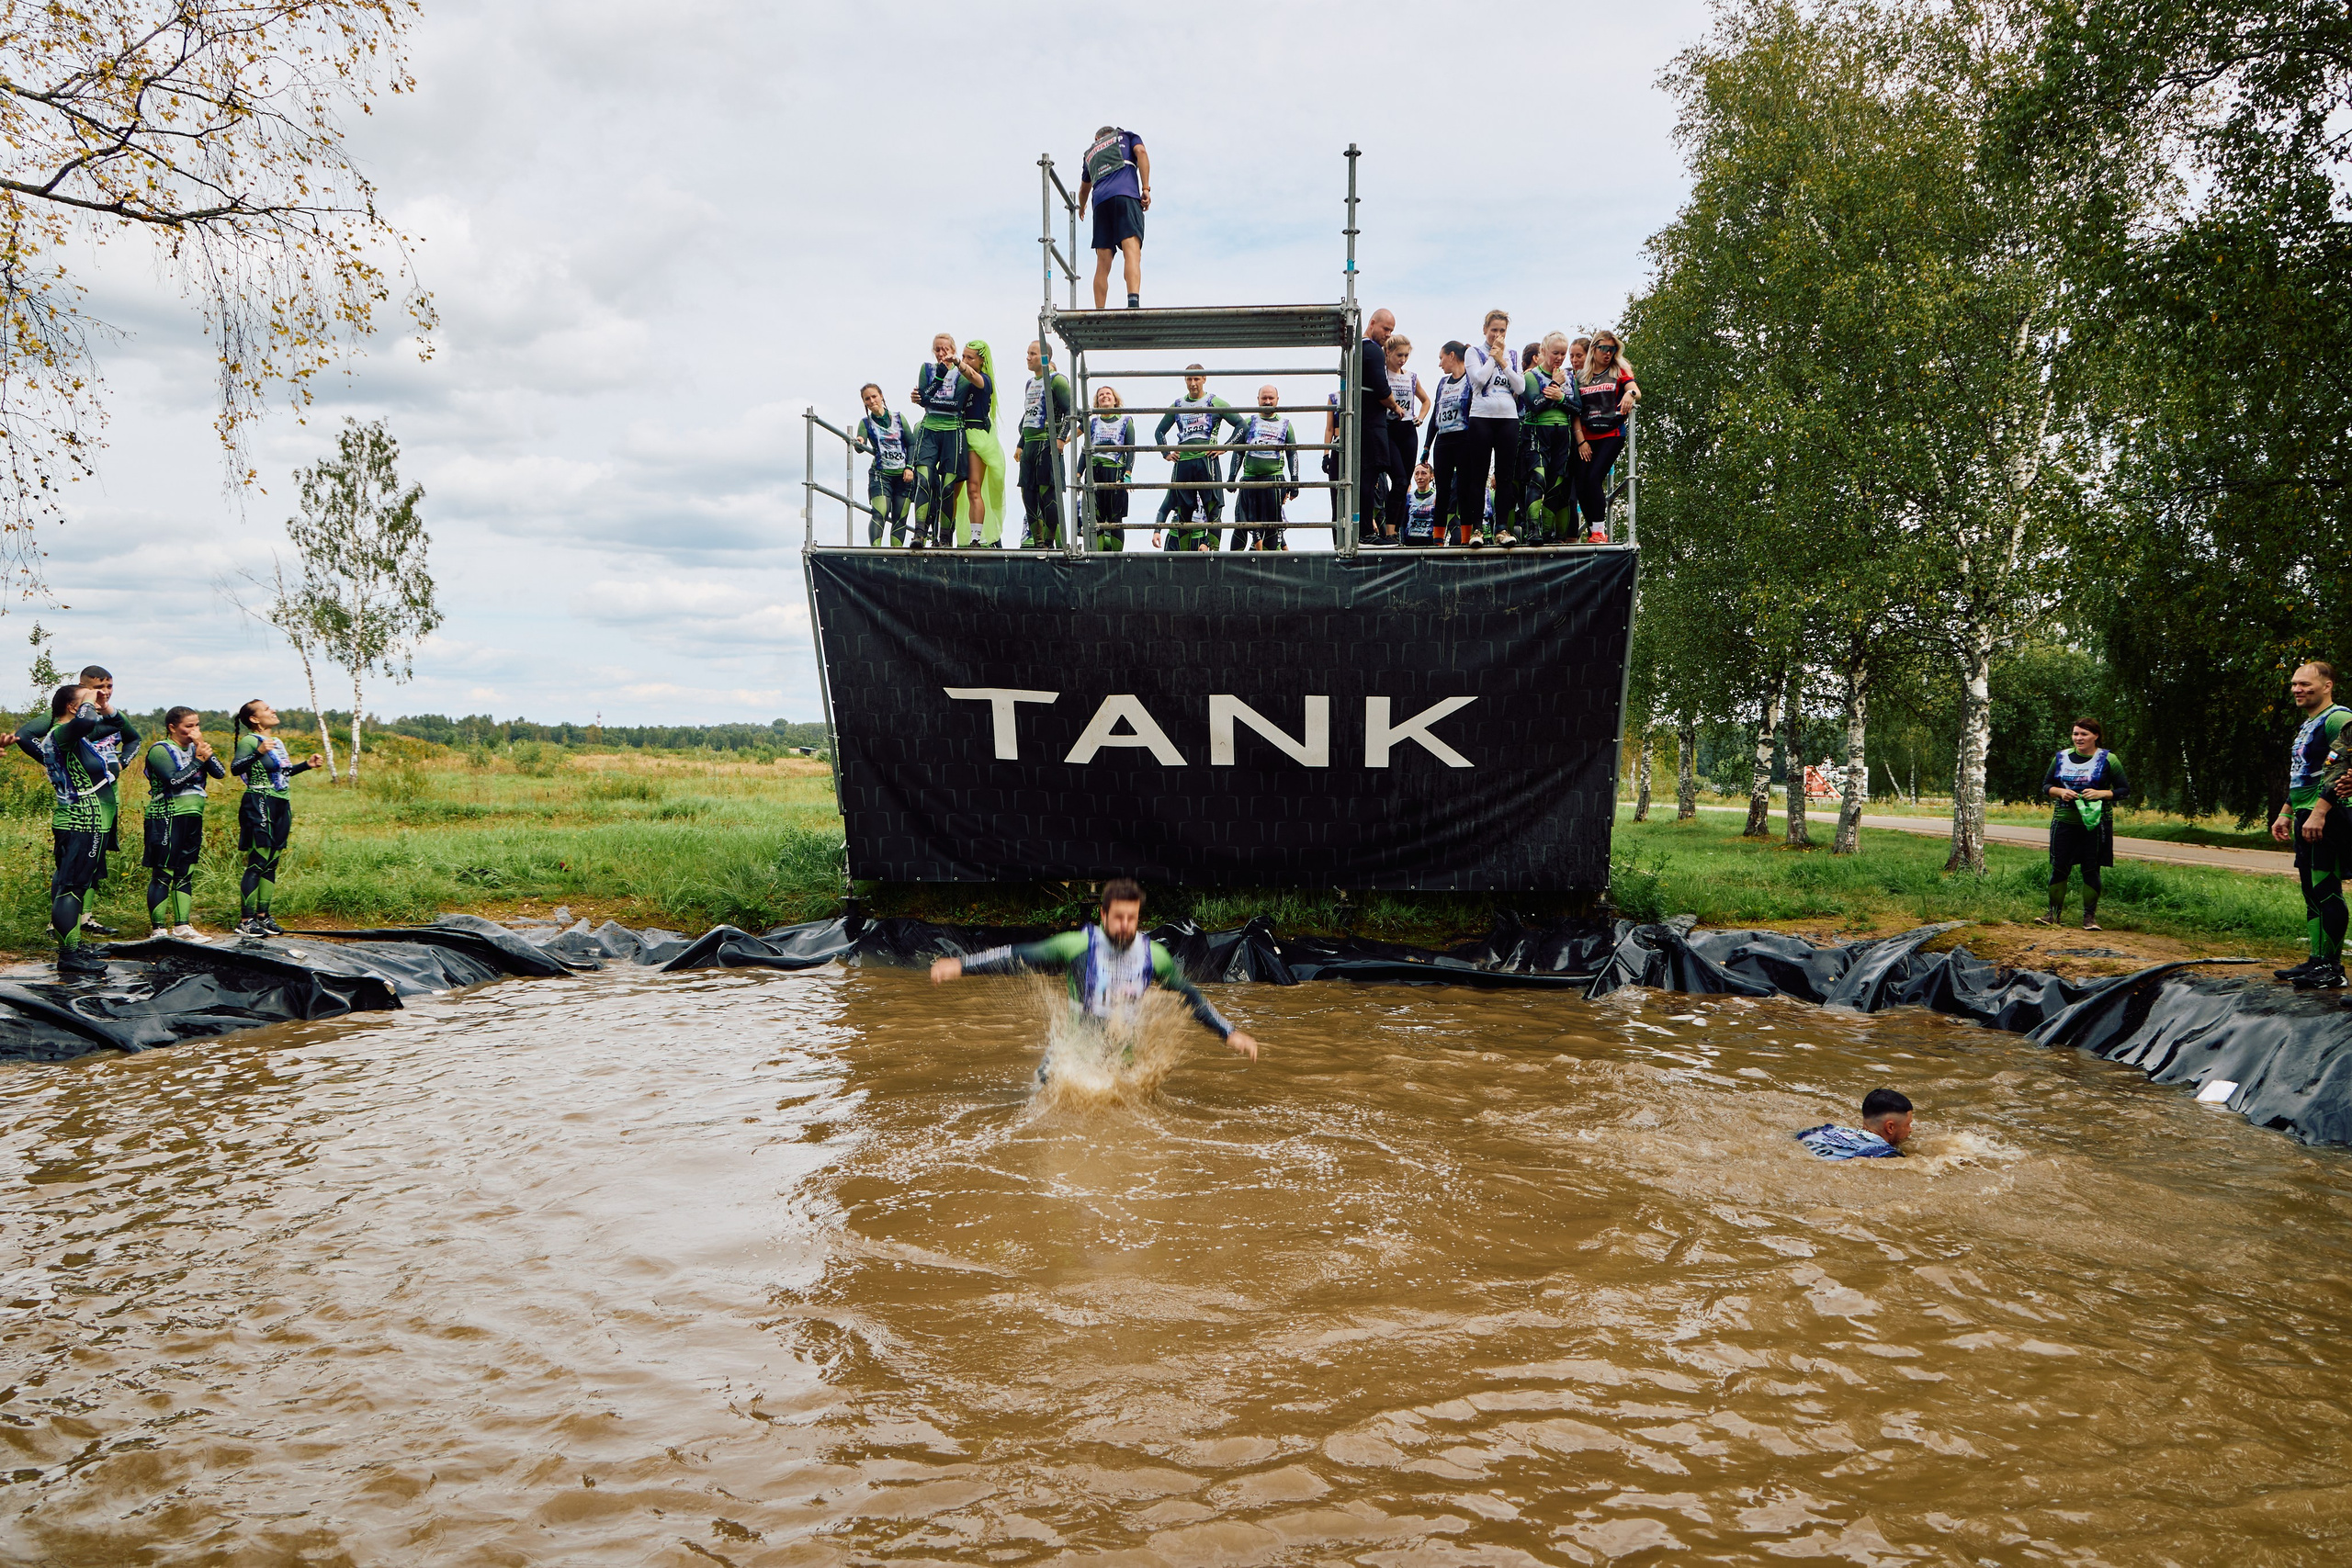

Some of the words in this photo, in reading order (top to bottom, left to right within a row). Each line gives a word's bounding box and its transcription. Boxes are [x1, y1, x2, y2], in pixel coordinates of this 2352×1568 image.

[930, 398, 958, 406] Greenway
[1439, 409, 1459, 423] 1337
[943, 687, 1479, 767] TANK
[210, 756, 226, 774] Green
[170, 766, 198, 785] Greenway
[88, 831, 99, 858] Green
